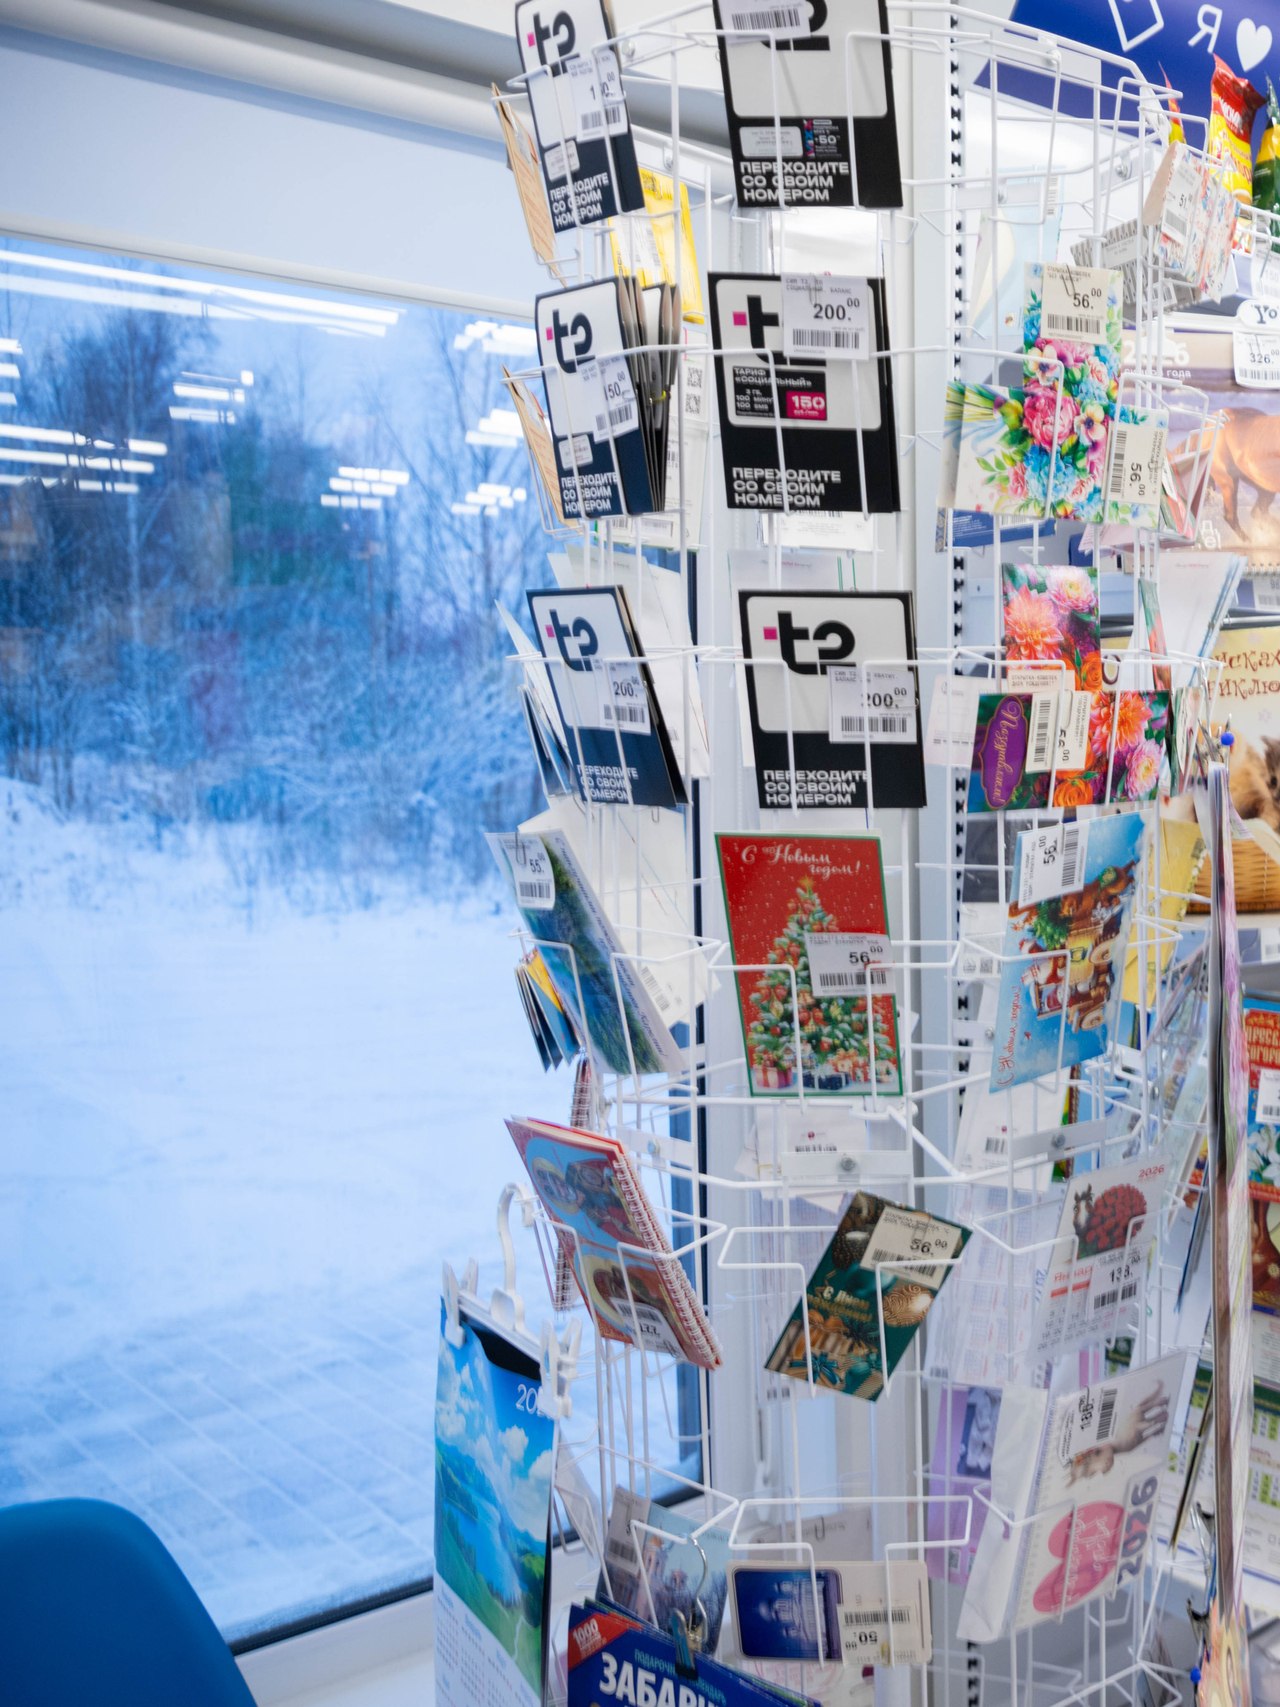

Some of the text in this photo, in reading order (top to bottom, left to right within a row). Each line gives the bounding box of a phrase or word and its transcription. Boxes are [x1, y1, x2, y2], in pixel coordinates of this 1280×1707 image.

[1188, 6, 1222, 54] Я
[740, 161, 849, 175] ПЕРЕХОДИТЕ
[741, 175, 834, 188] СО СВОИМ
[743, 188, 830, 202] НОМЕРОМ
[552, 199, 567, 215] СО
[734, 367, 767, 377] ТАРИФ
[1166, 368, 1191, 379] года
[791, 395, 825, 409] 150
[733, 480, 758, 493] СО
[562, 489, 576, 502] СО
[763, 610, 856, 675] t2
[993, 700, 1022, 803] Поздравляем!
[764, 781, 857, 794] СО СВОИМ
[741, 843, 832, 865] С Новым
[808, 860, 862, 881] годом!
[1138, 1165, 1165, 1179] 2026
[1116, 1475, 1158, 1585] 2026
[572, 1618, 599, 1644] 1000
